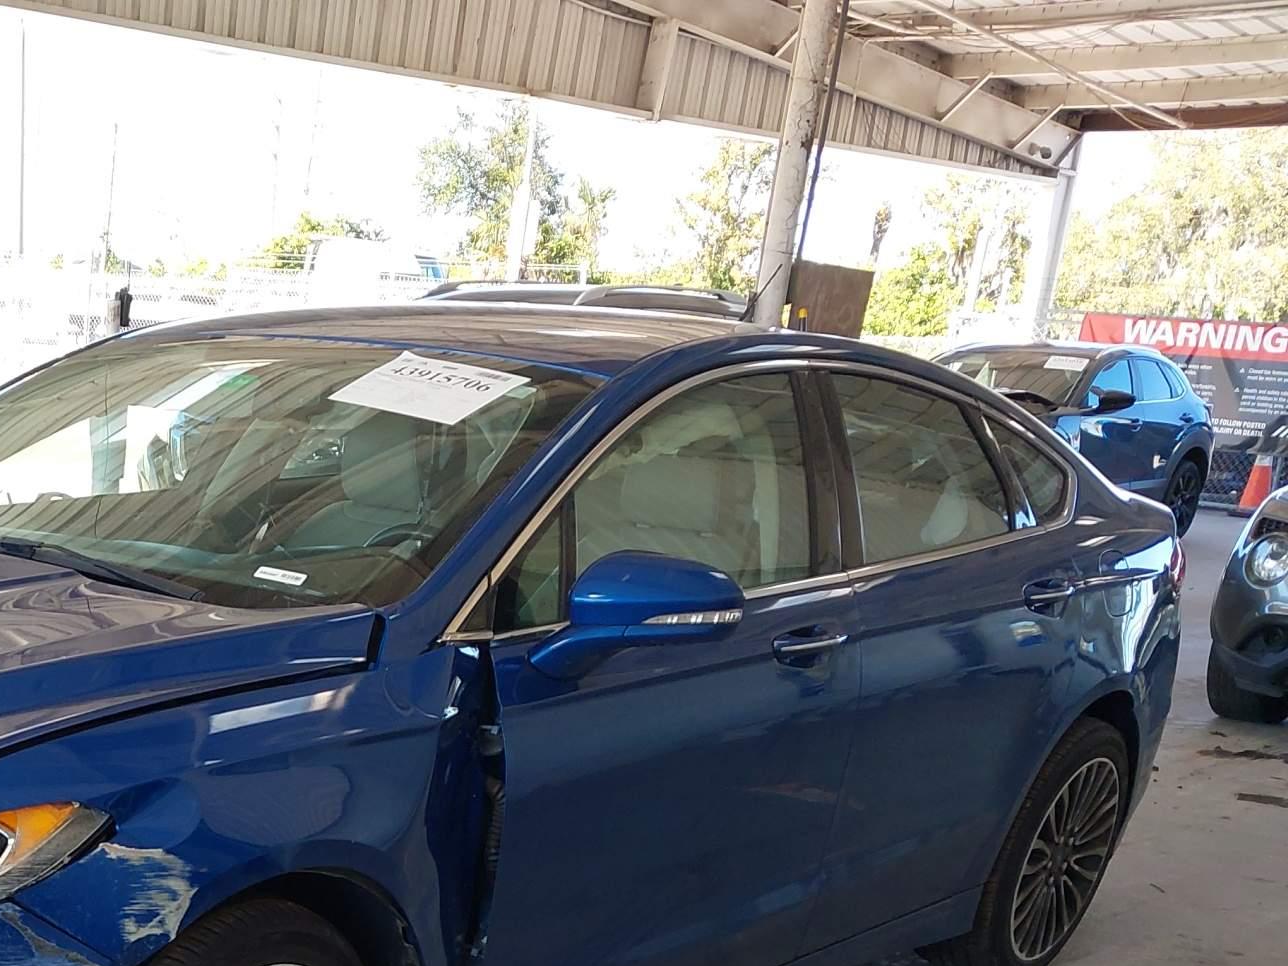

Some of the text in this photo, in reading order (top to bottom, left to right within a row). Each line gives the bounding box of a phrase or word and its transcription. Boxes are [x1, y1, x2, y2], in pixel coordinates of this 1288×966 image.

[1123, 318, 1288, 354] WARNING
[390, 365, 492, 393] 43915706
[1220, 418, 1243, 428] FOLLOW
[1243, 421, 1267, 430] POSTED
